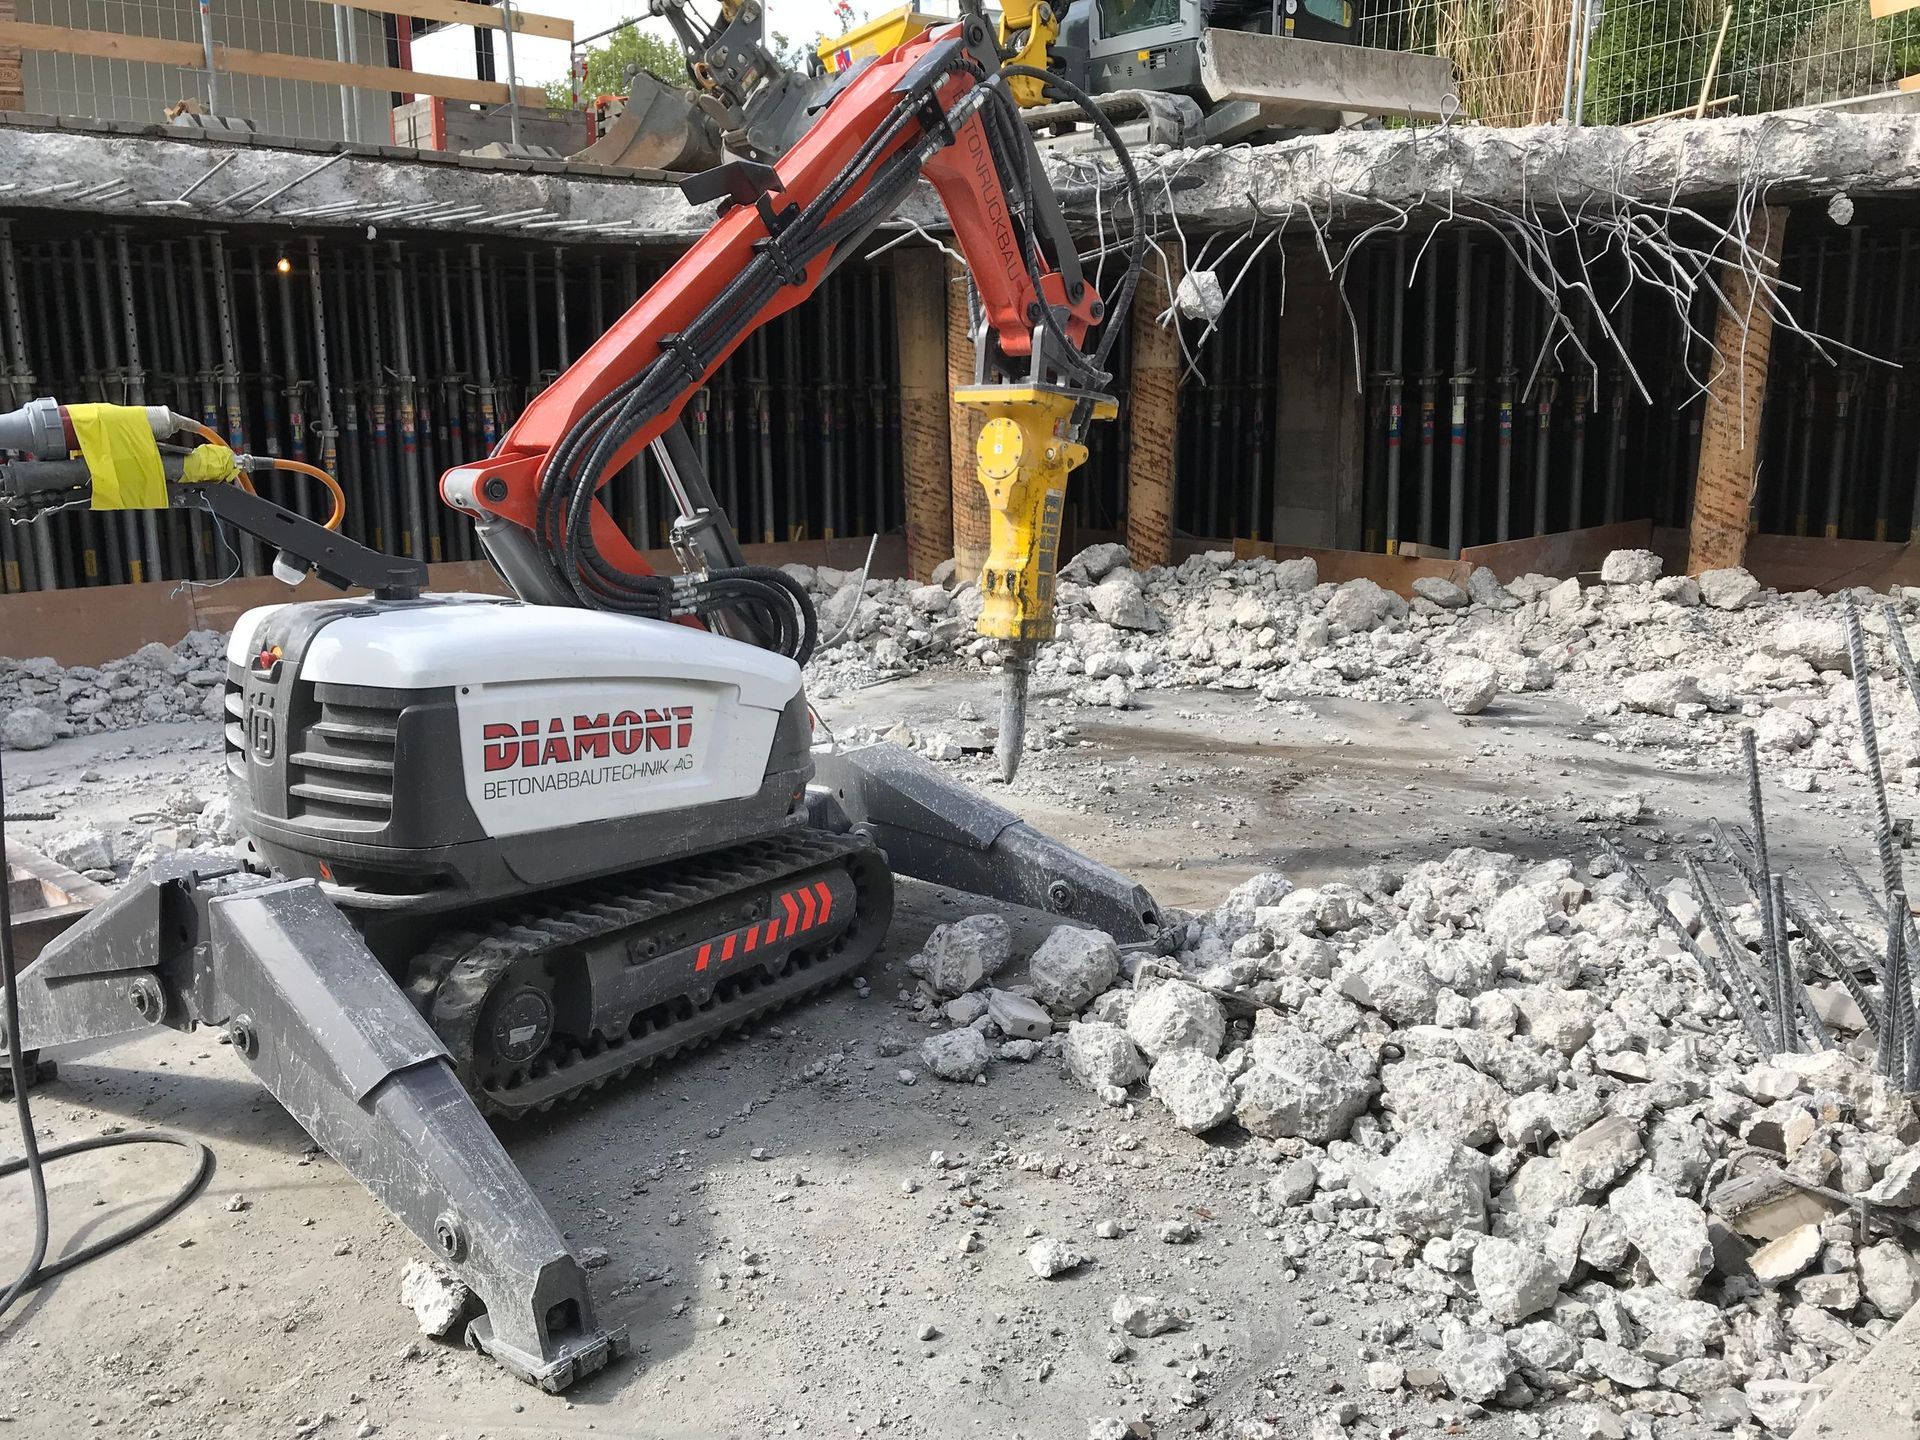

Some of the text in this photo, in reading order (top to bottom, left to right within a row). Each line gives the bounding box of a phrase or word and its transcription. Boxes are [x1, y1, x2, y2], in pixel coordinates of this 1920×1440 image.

[953, 89, 1021, 281] BTONRÜCKBAU
[483, 706, 694, 773] DIAMONT
[484, 754, 693, 800] BETONABBAUTECHNIK AG
